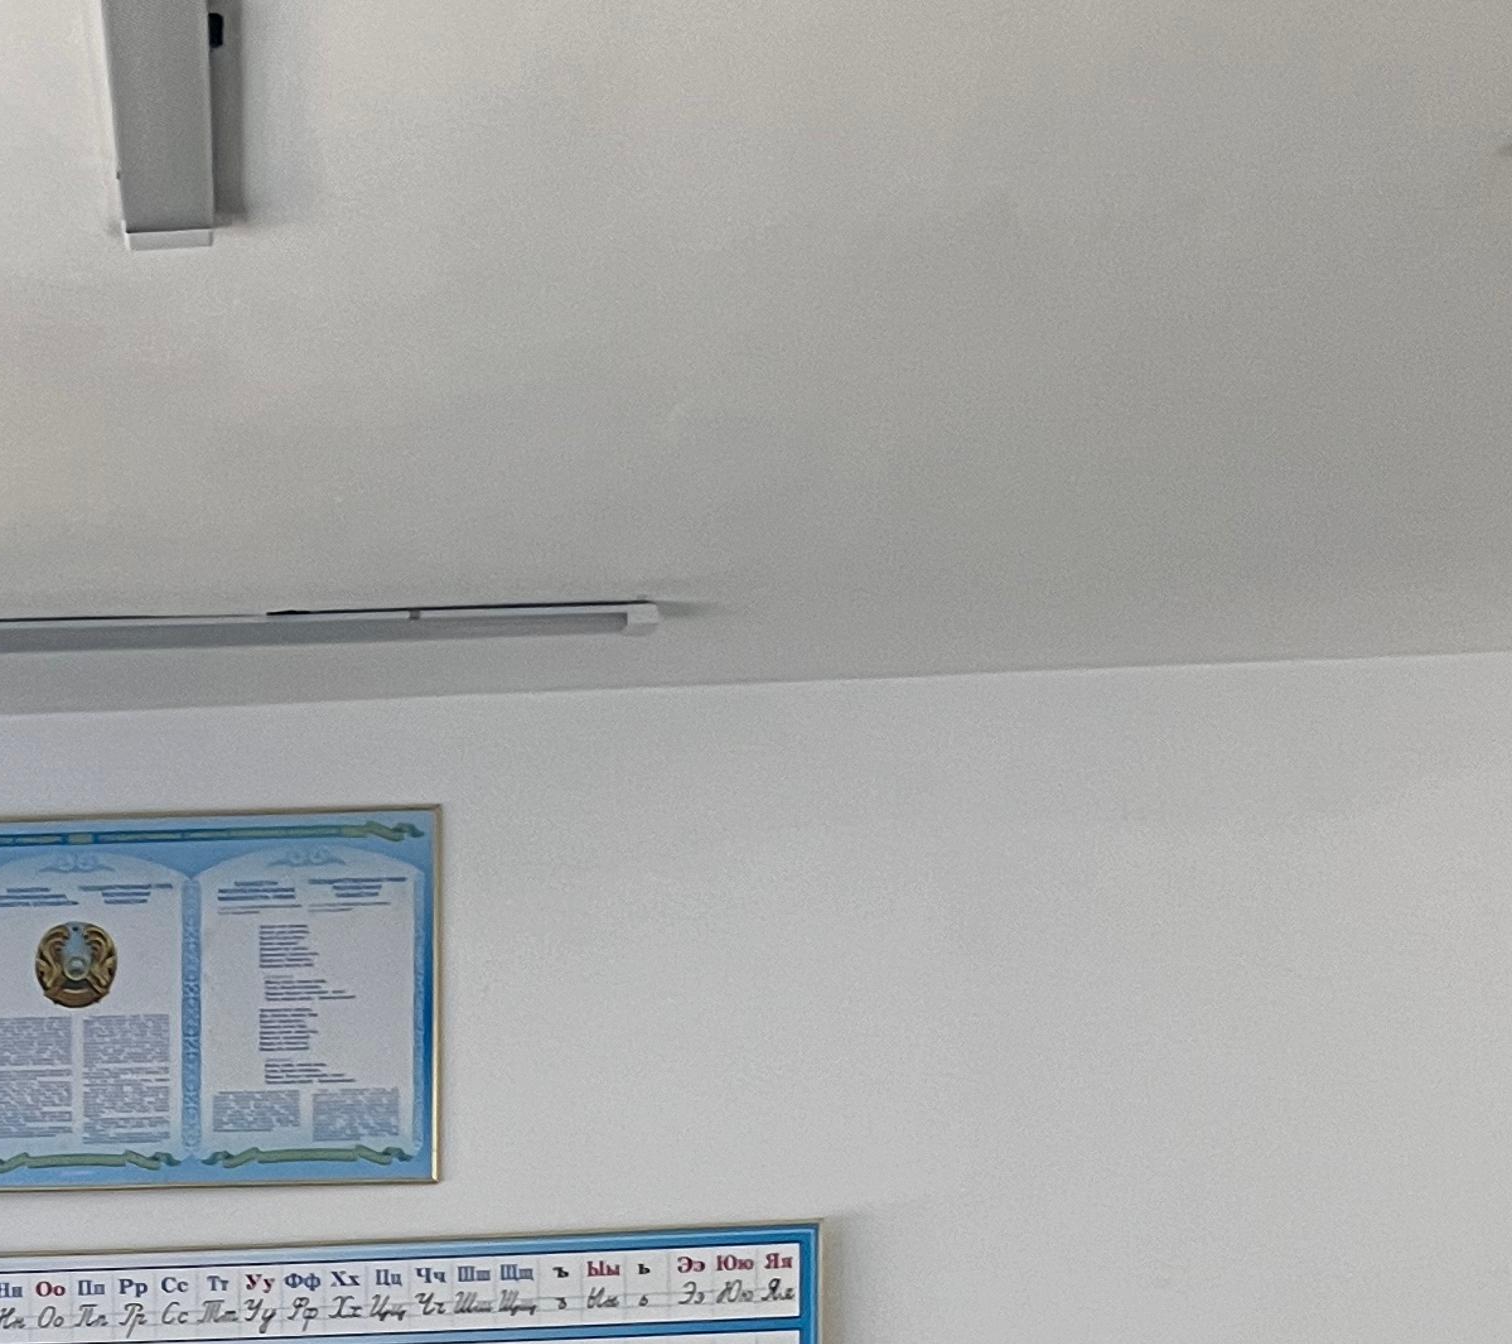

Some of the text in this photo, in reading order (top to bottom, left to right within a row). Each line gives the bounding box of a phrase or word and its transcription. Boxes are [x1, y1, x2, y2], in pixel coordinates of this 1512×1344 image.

[36, 1281, 65, 1296] Оо
[119, 1278, 148, 1297] Рр
[161, 1277, 188, 1292] Сс
[207, 1276, 229, 1291] Тт
[246, 1275, 275, 1293] Уу
[284, 1273, 321, 1291] Фф
[331, 1272, 360, 1287] Хх
[677, 1256, 705, 1273] Ээ
[716, 1255, 754, 1270] Юю
